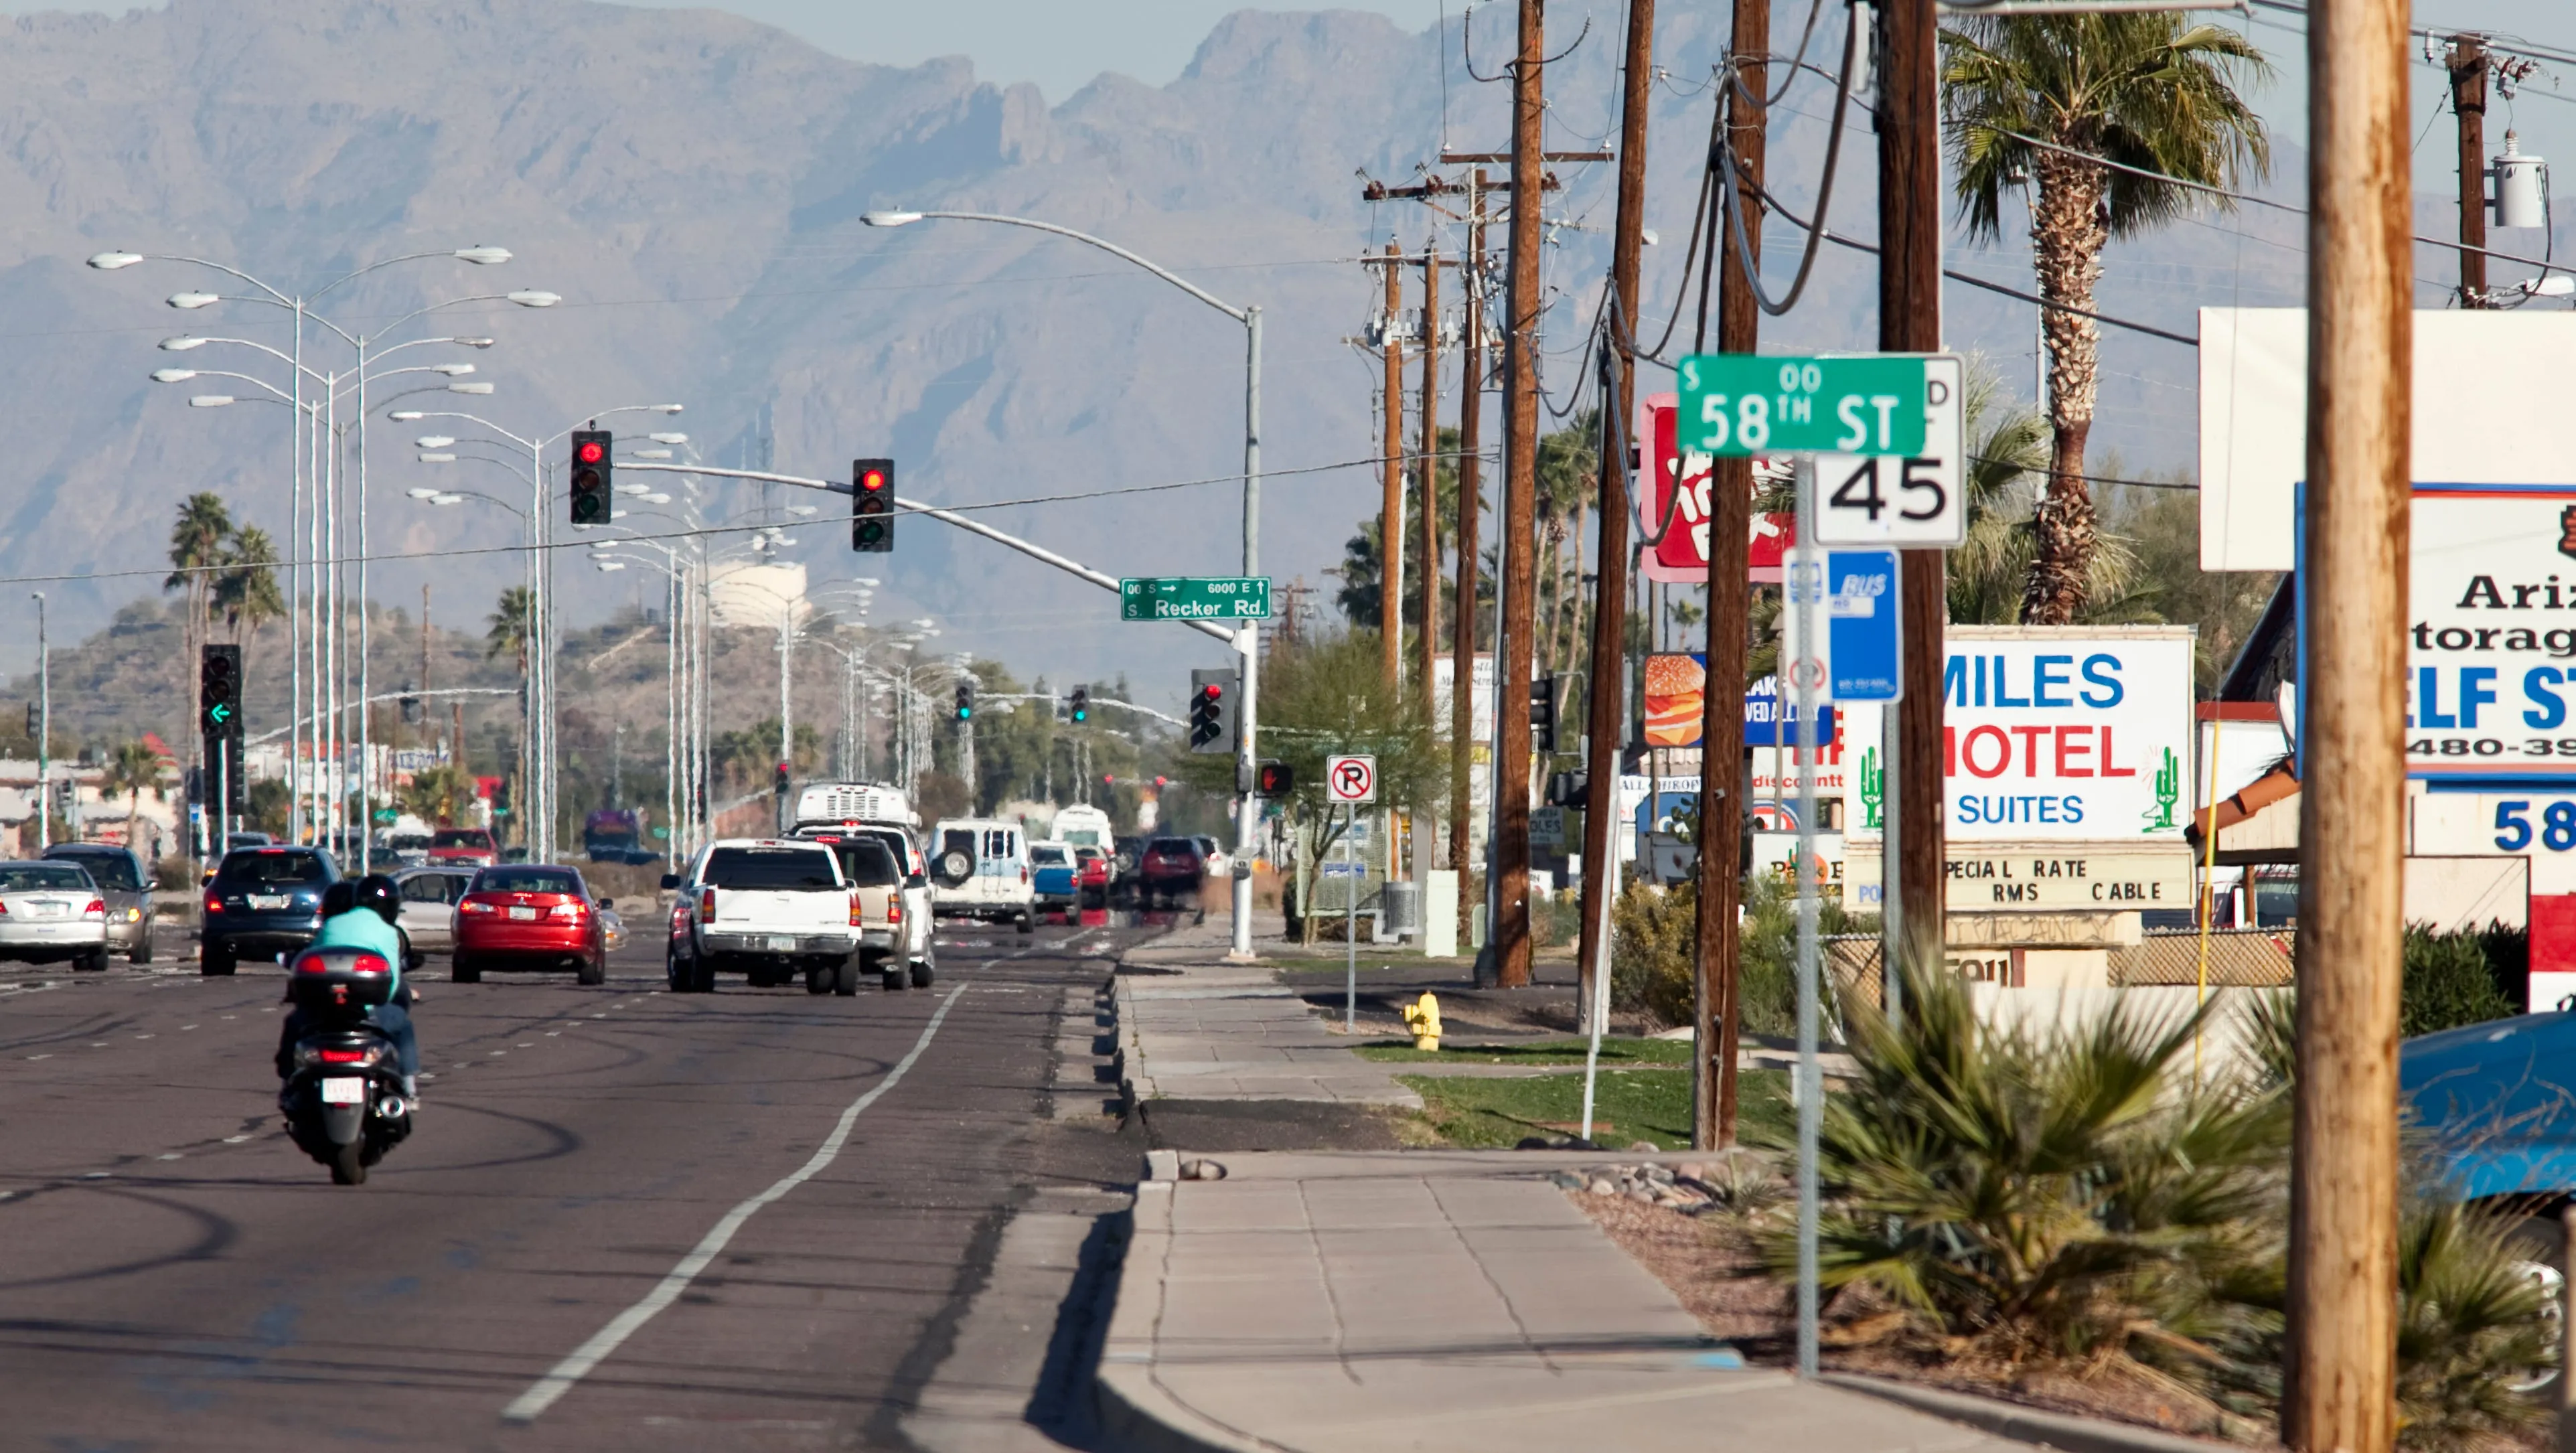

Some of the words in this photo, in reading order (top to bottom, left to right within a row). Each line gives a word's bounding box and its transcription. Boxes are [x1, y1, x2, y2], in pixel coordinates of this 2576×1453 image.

[1683, 360, 1701, 391] S
[1778, 362, 1822, 393] 00
[1836, 394, 1900, 451] ST
[1829, 458, 1947, 521] 45
[1127, 584, 1141, 594] 00
[1207, 583, 1236, 594] 6000
[1242, 583, 1250, 593] E
[1841, 574, 1888, 597] BUS
[2456, 575, 2576, 609] Ari
[1155, 599, 1222, 617] Recker
[1234, 599, 1265, 615] Rd.
[2406, 666, 2497, 729] LF
[2522, 666, 2576, 730] S
[1943, 724, 2136, 778] OTEL
[1958, 795, 2084, 824] SUITES
[2034, 860, 2087, 878] RATE
[1993, 883, 2038, 902] RMS
[2092, 882, 2161, 900] CABLE
